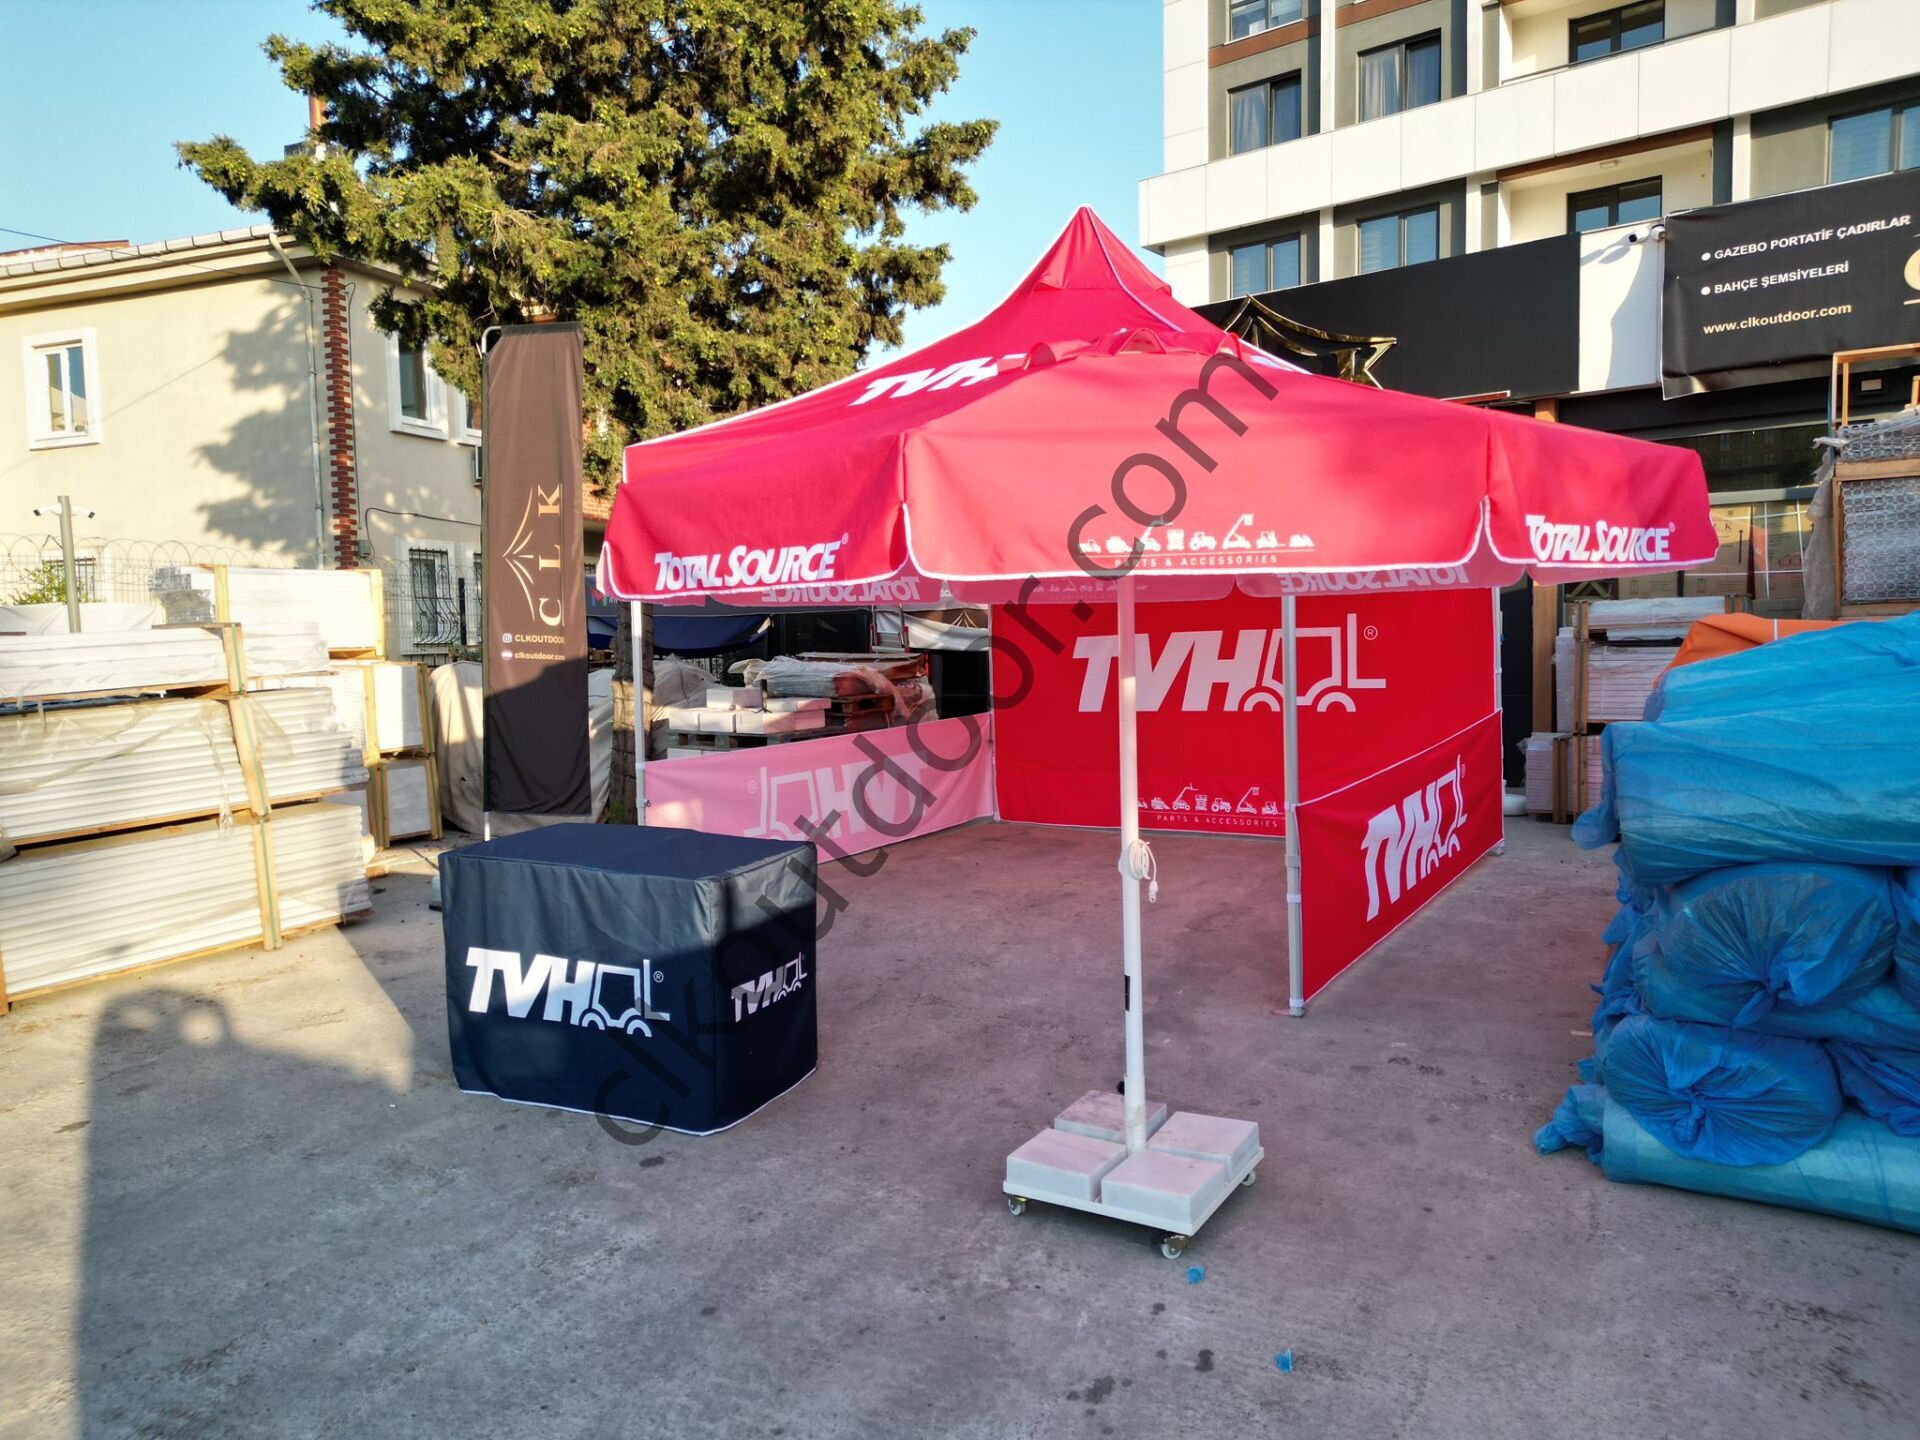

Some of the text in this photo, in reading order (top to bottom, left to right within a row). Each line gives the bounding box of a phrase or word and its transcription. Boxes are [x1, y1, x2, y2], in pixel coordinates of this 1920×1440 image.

[1714, 215, 1911, 260] GAZEBO PORTATİF ÇADIRLAR
[1714, 260, 1849, 294] BAHÇE ŞEMSİYELERİ
[1703, 303, 1851, 334] www.clkoutdoor.com
[1525, 514, 1591, 562] TOTAL
[654, 553, 724, 591] TOTAL
[1115, 554, 1278, 568] PARTS & ACCESSORIES
[1157, 814, 1188, 823] PARTS
[1205, 817, 1279, 828] ACCESSORIES
[466, 946, 595, 1026] TVH
